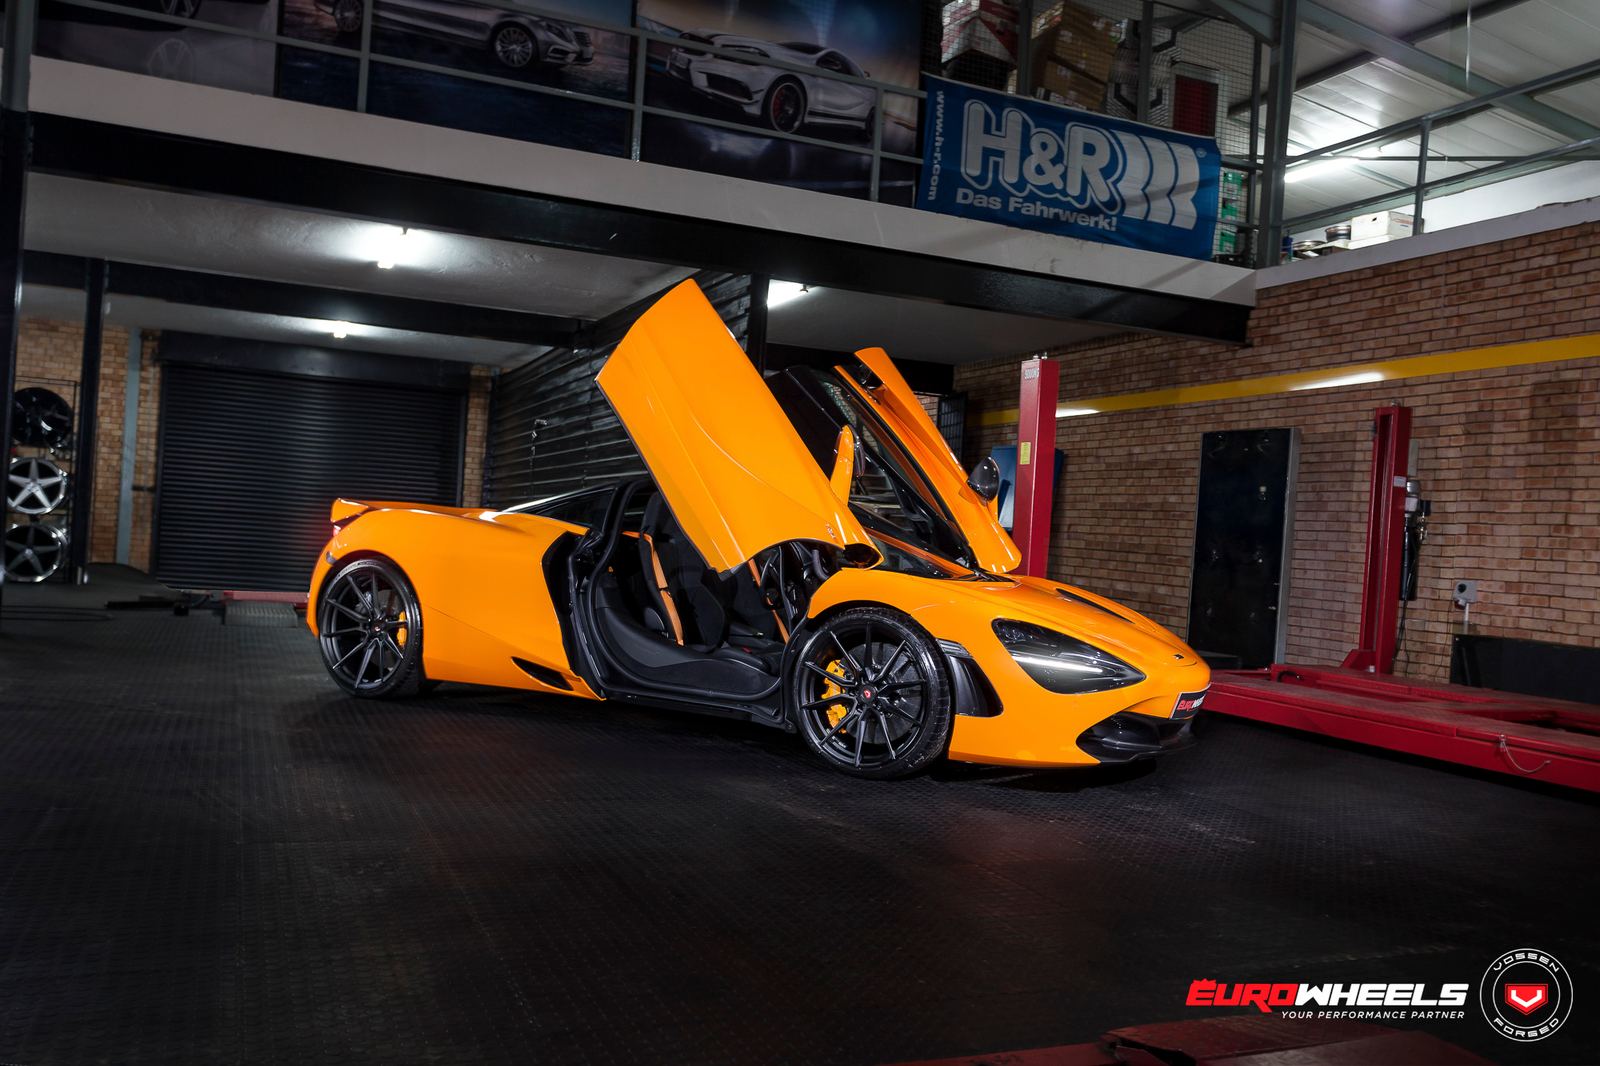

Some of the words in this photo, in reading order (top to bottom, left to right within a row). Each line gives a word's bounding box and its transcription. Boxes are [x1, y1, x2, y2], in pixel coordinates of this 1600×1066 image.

[961, 99, 1121, 214] H&R
[956, 187, 1001, 210] Das
[1008, 196, 1118, 232] Fahrwerk!
